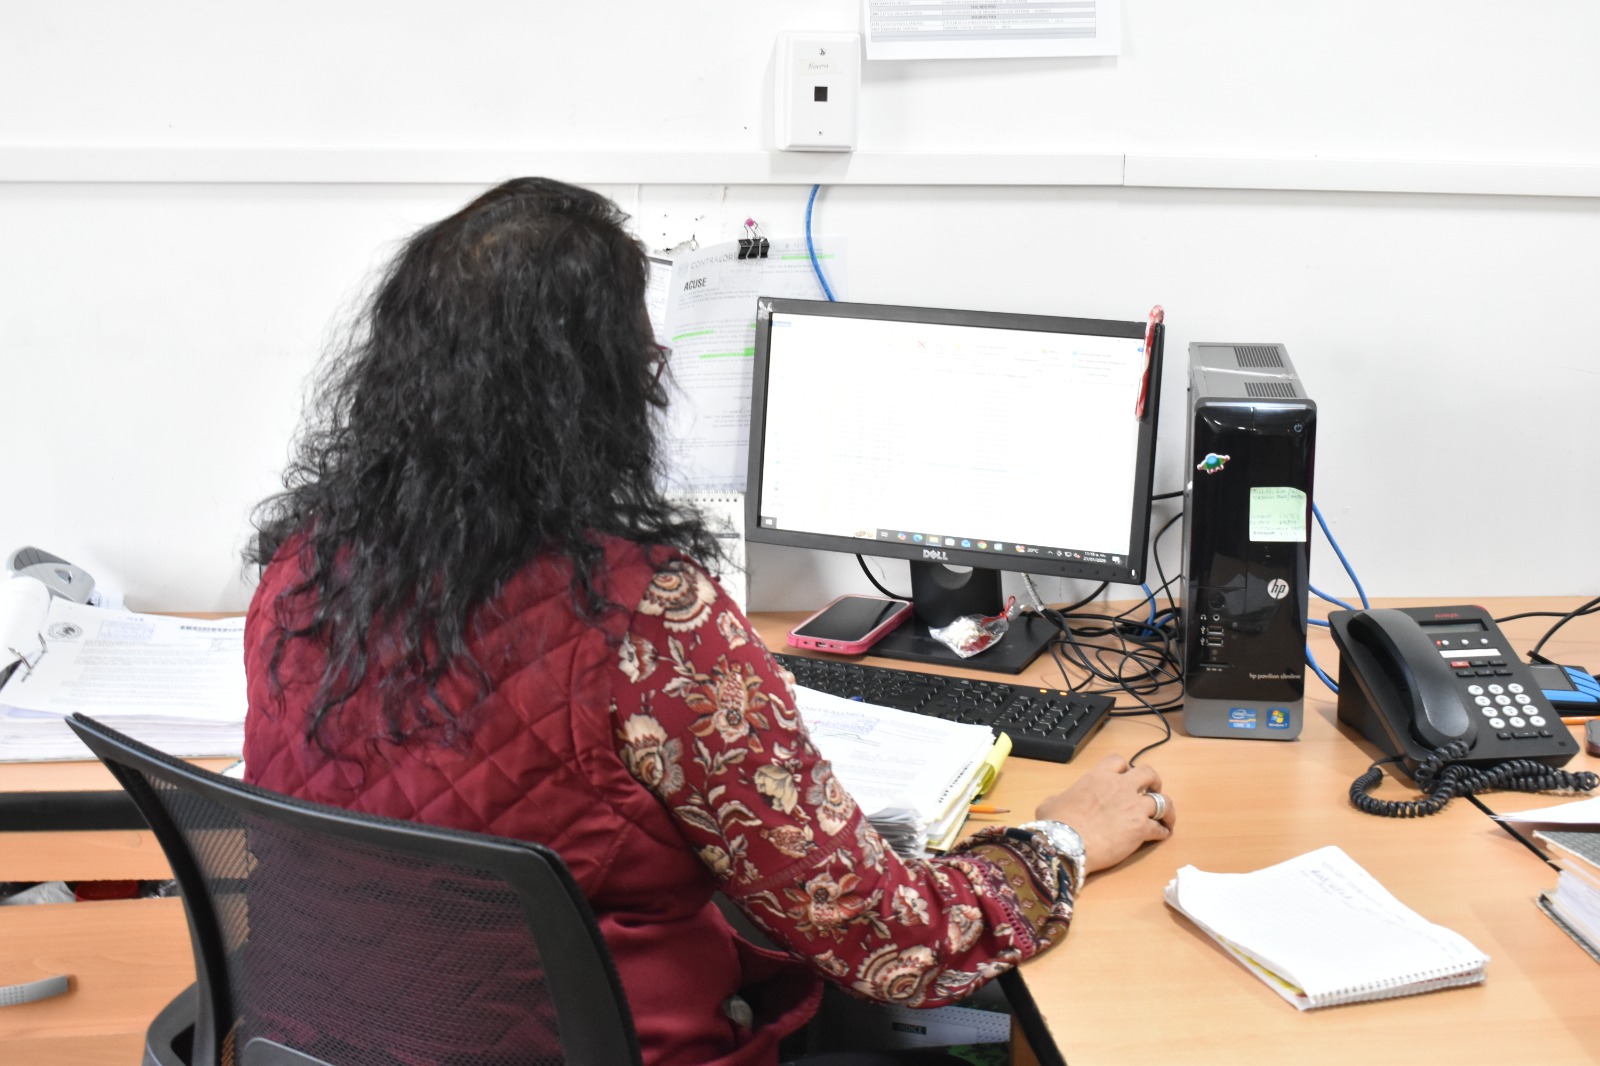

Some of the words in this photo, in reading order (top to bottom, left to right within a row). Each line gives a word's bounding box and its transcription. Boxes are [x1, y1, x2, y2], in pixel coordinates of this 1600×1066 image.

[683, 277, 707, 291] ACUSE
[922, 549, 948, 561] DELL
[1269, 578, 1287, 600] hp
[1249, 672, 1257, 680] hp
[1257, 672, 1279, 680] pavilion
